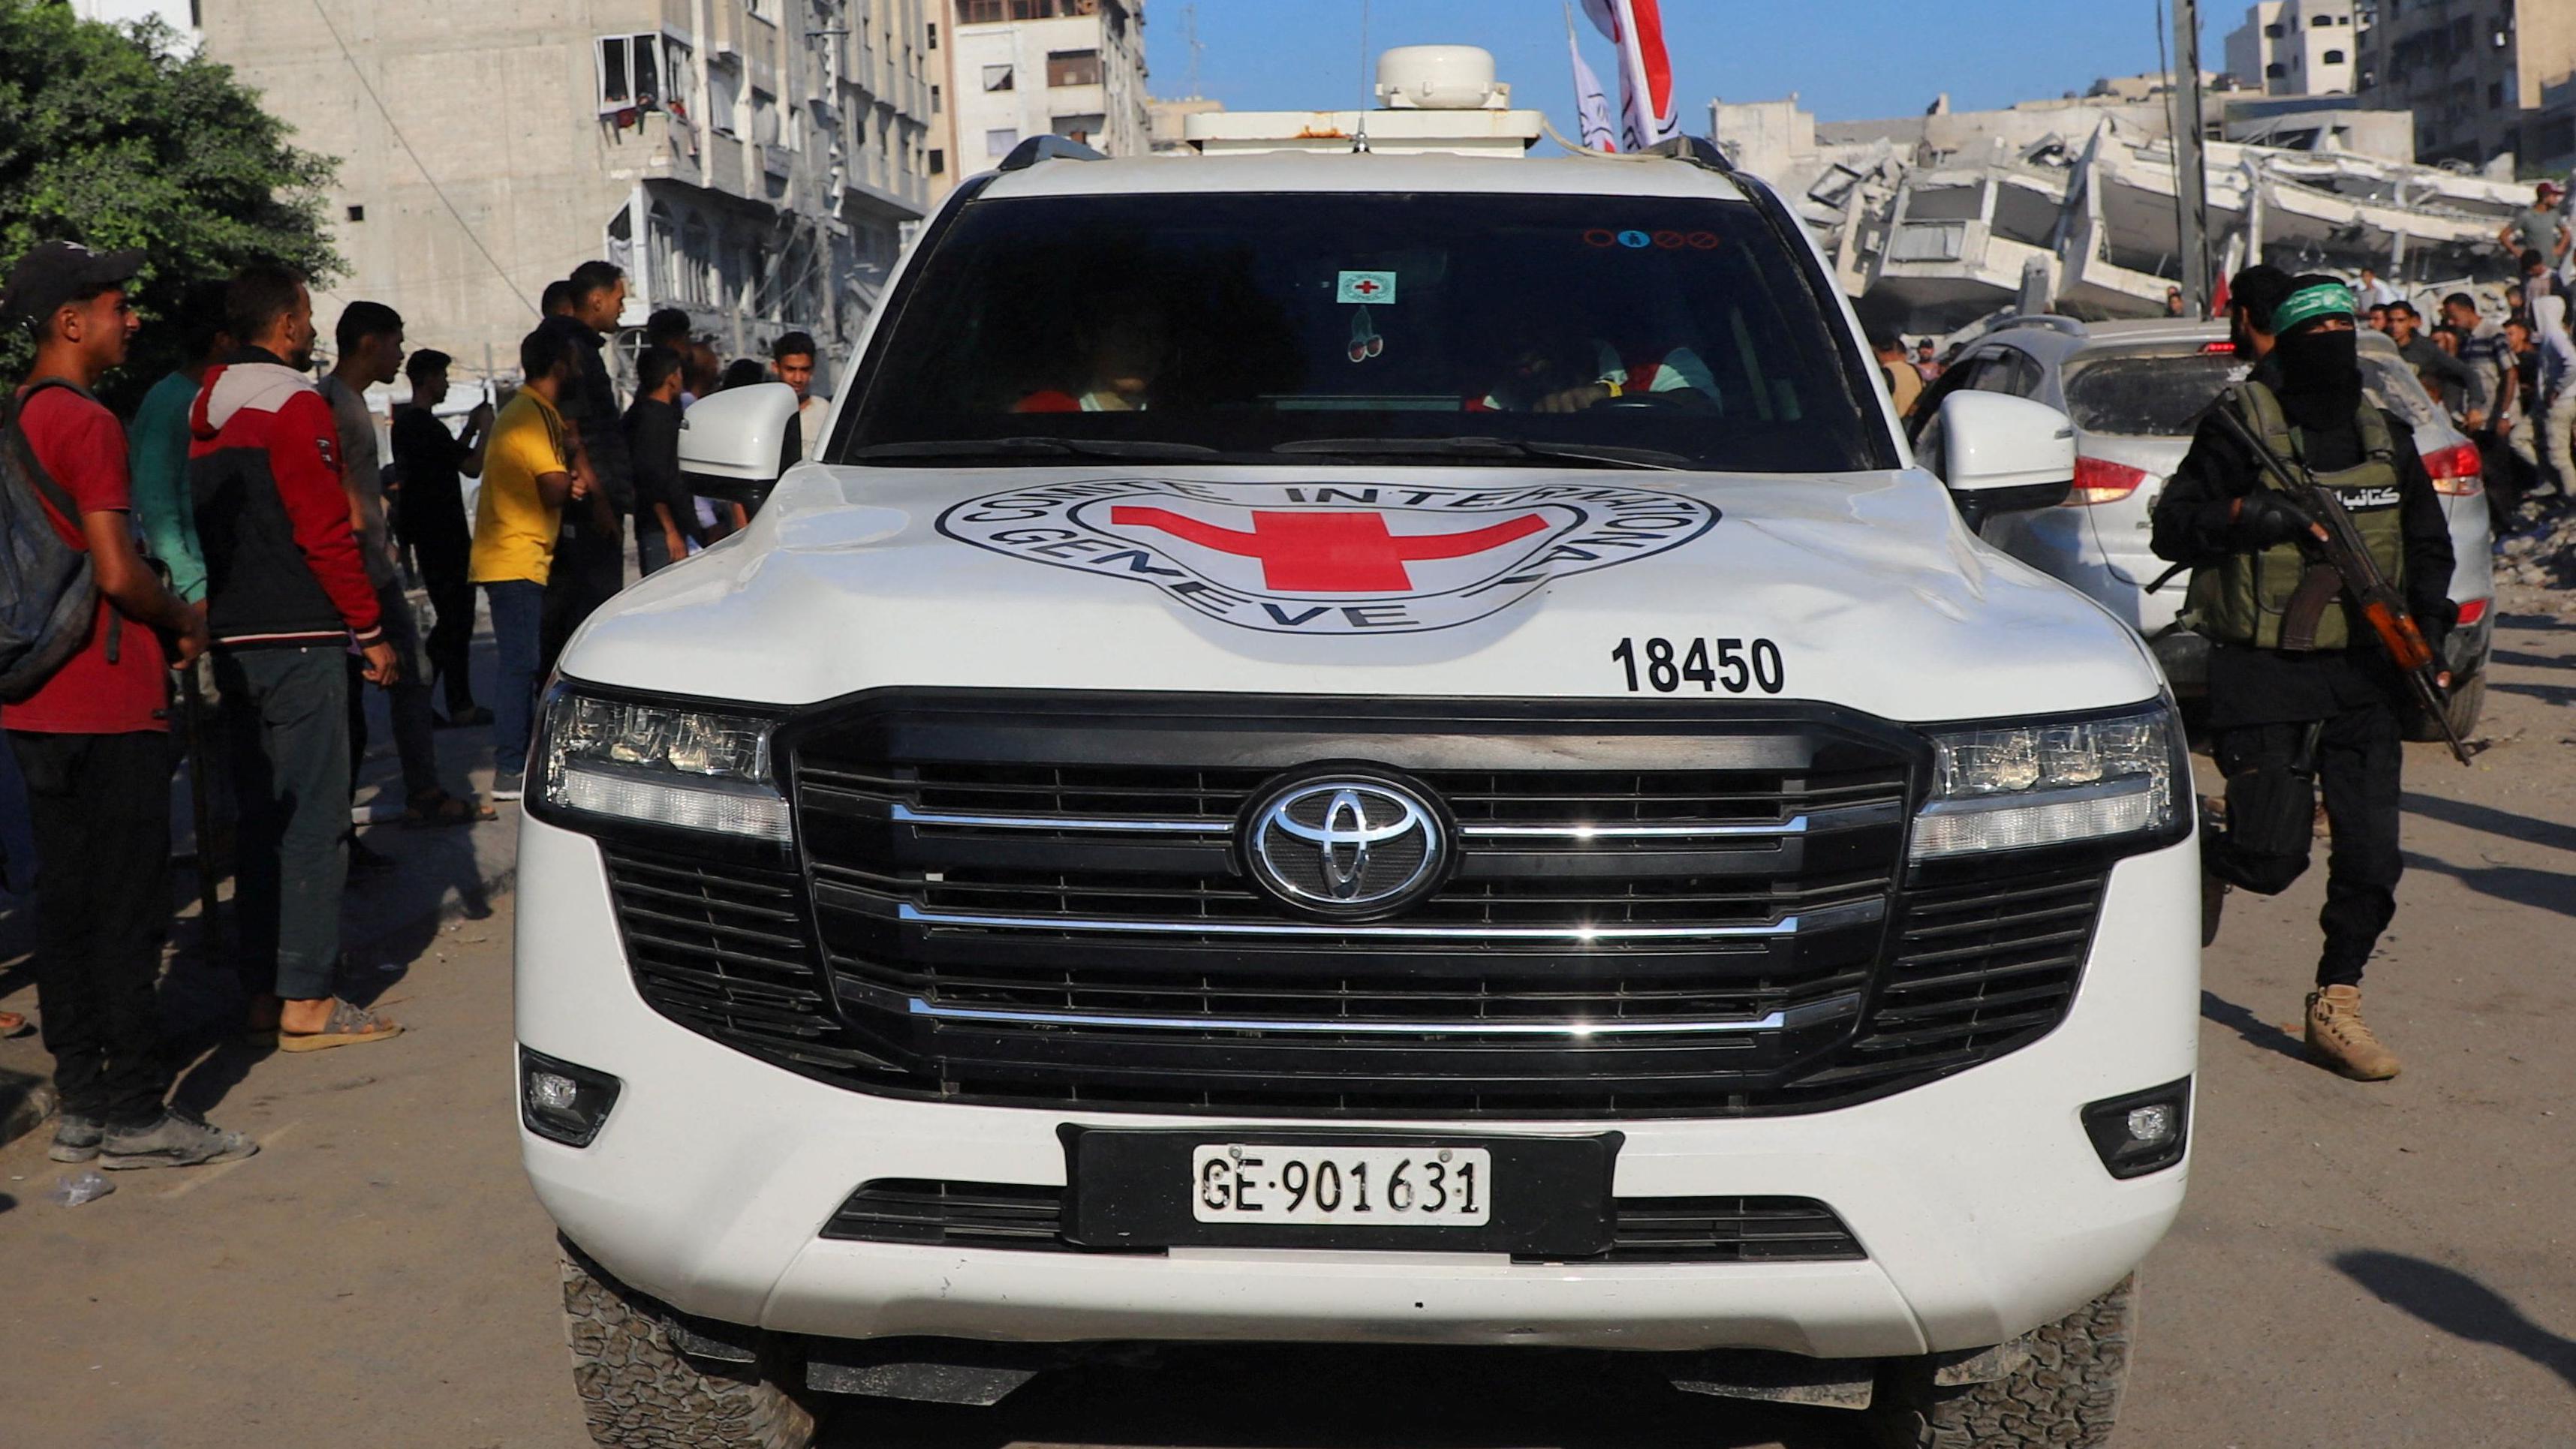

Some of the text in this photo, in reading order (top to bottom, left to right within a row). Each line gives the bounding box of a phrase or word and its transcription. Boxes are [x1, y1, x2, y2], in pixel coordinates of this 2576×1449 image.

[962, 481, 1699, 598] COMITE INTERNATIONAL
[989, 528, 1421, 627] GENEVE
[1612, 637, 1784, 694] 18450
